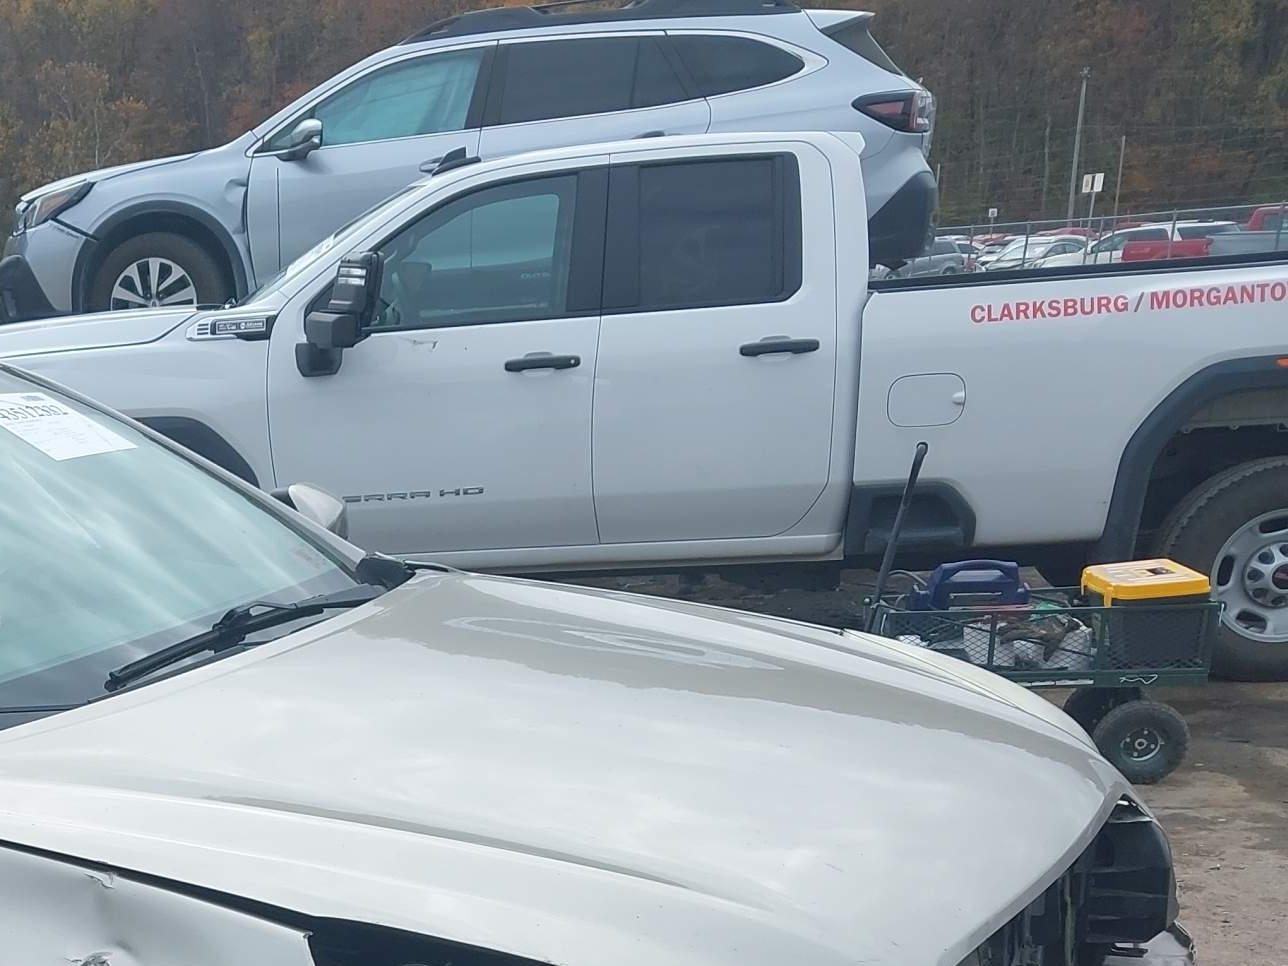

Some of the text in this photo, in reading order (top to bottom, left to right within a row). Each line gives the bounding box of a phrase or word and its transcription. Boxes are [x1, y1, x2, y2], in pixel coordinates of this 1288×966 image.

[970, 295, 1129, 324] CLARKSBURG
[1150, 282, 1288, 310] MORGANTO
[342, 487, 484, 503] ERRA HD
